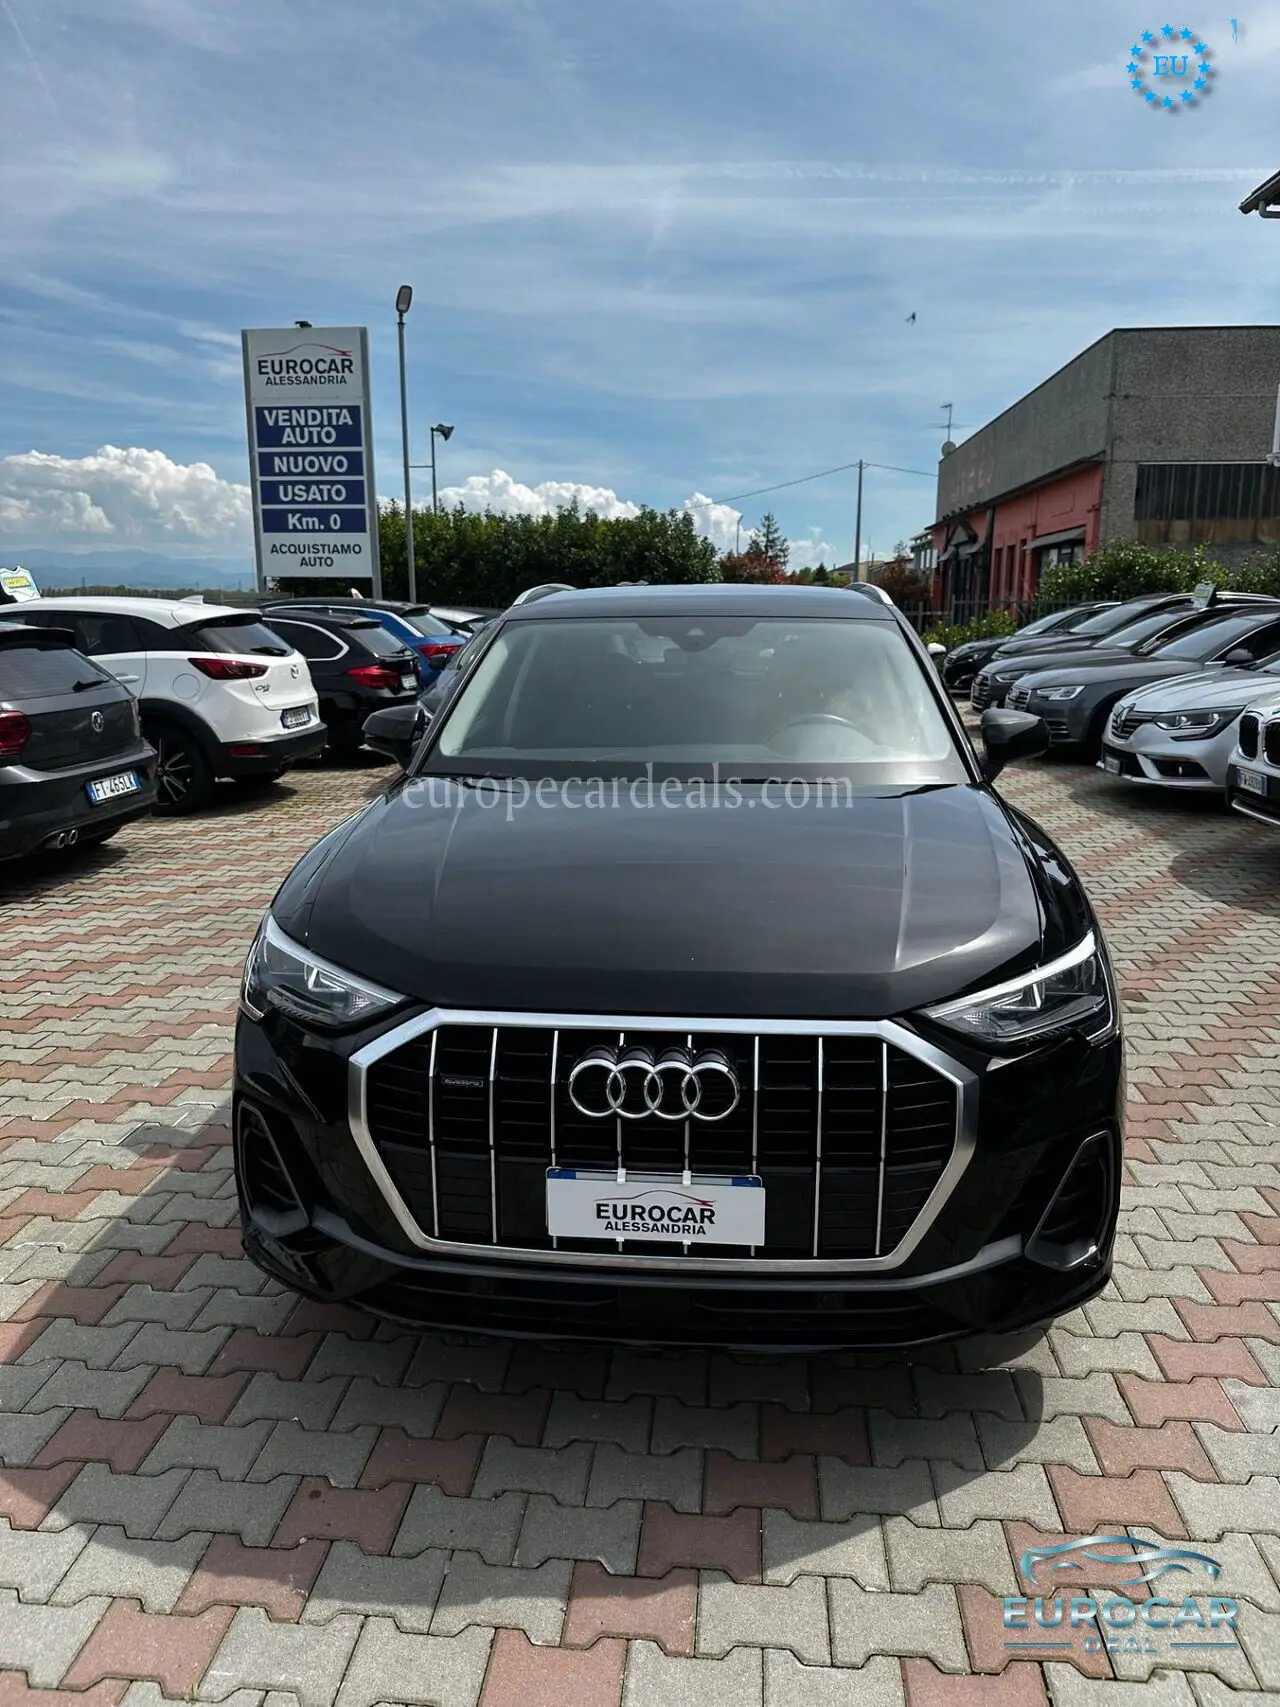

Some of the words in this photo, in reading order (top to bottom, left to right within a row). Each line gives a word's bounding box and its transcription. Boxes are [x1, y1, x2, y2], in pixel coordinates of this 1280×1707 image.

[257, 358, 354, 375] EUROCAR
[265, 374, 347, 386] ALESSANDRIA
[263, 408, 353, 427] VENDITA
[281, 426, 337, 444] AUTO
[273, 454, 348, 474] NUOVO
[278, 483, 347, 502] USATO
[287, 512, 325, 530] Km.
[329, 512, 342, 530] 0
[270, 543, 362, 555] ACQUISTIAMO
[299, 556, 334, 568] AUTO
[596, 1202, 716, 1225] EUROCAR
[604, 1220, 707, 1235] ALESSANDRIA
